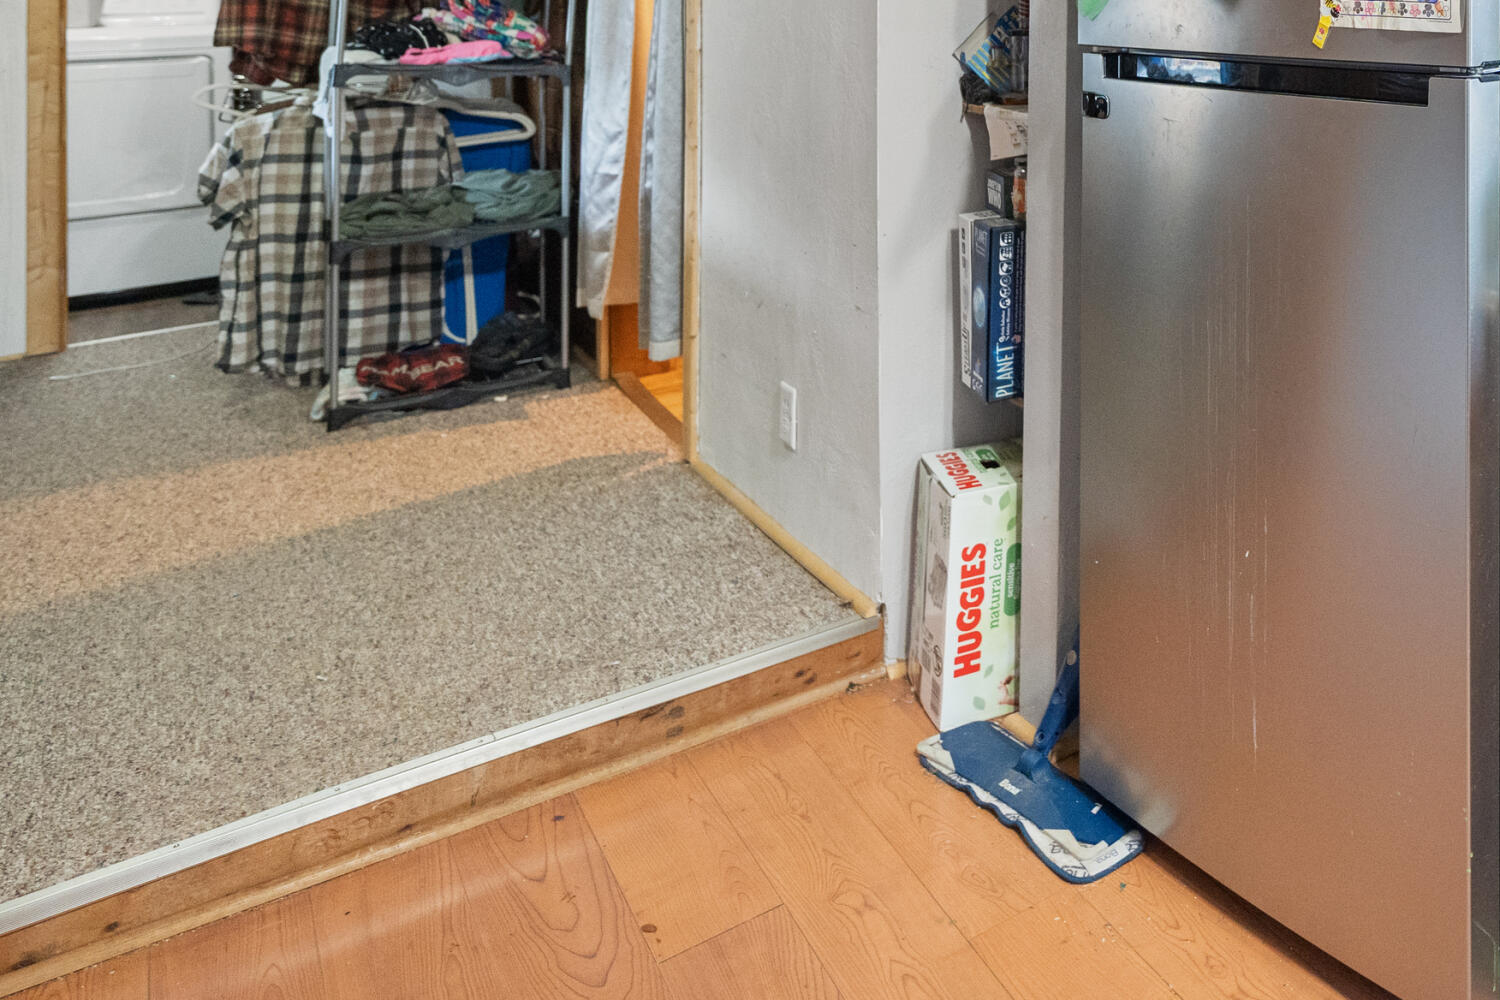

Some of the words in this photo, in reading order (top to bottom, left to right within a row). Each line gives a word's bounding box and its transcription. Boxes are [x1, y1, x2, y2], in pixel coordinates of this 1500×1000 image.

[995, 342, 1017, 399] PLANET
[936, 452, 982, 490] HUGGIES
[993, 538, 1003, 570] care
[989, 574, 1001, 629] natural
[1007, 562, 1015, 598] sensitive
[953, 542, 986, 678] HUGGIES
